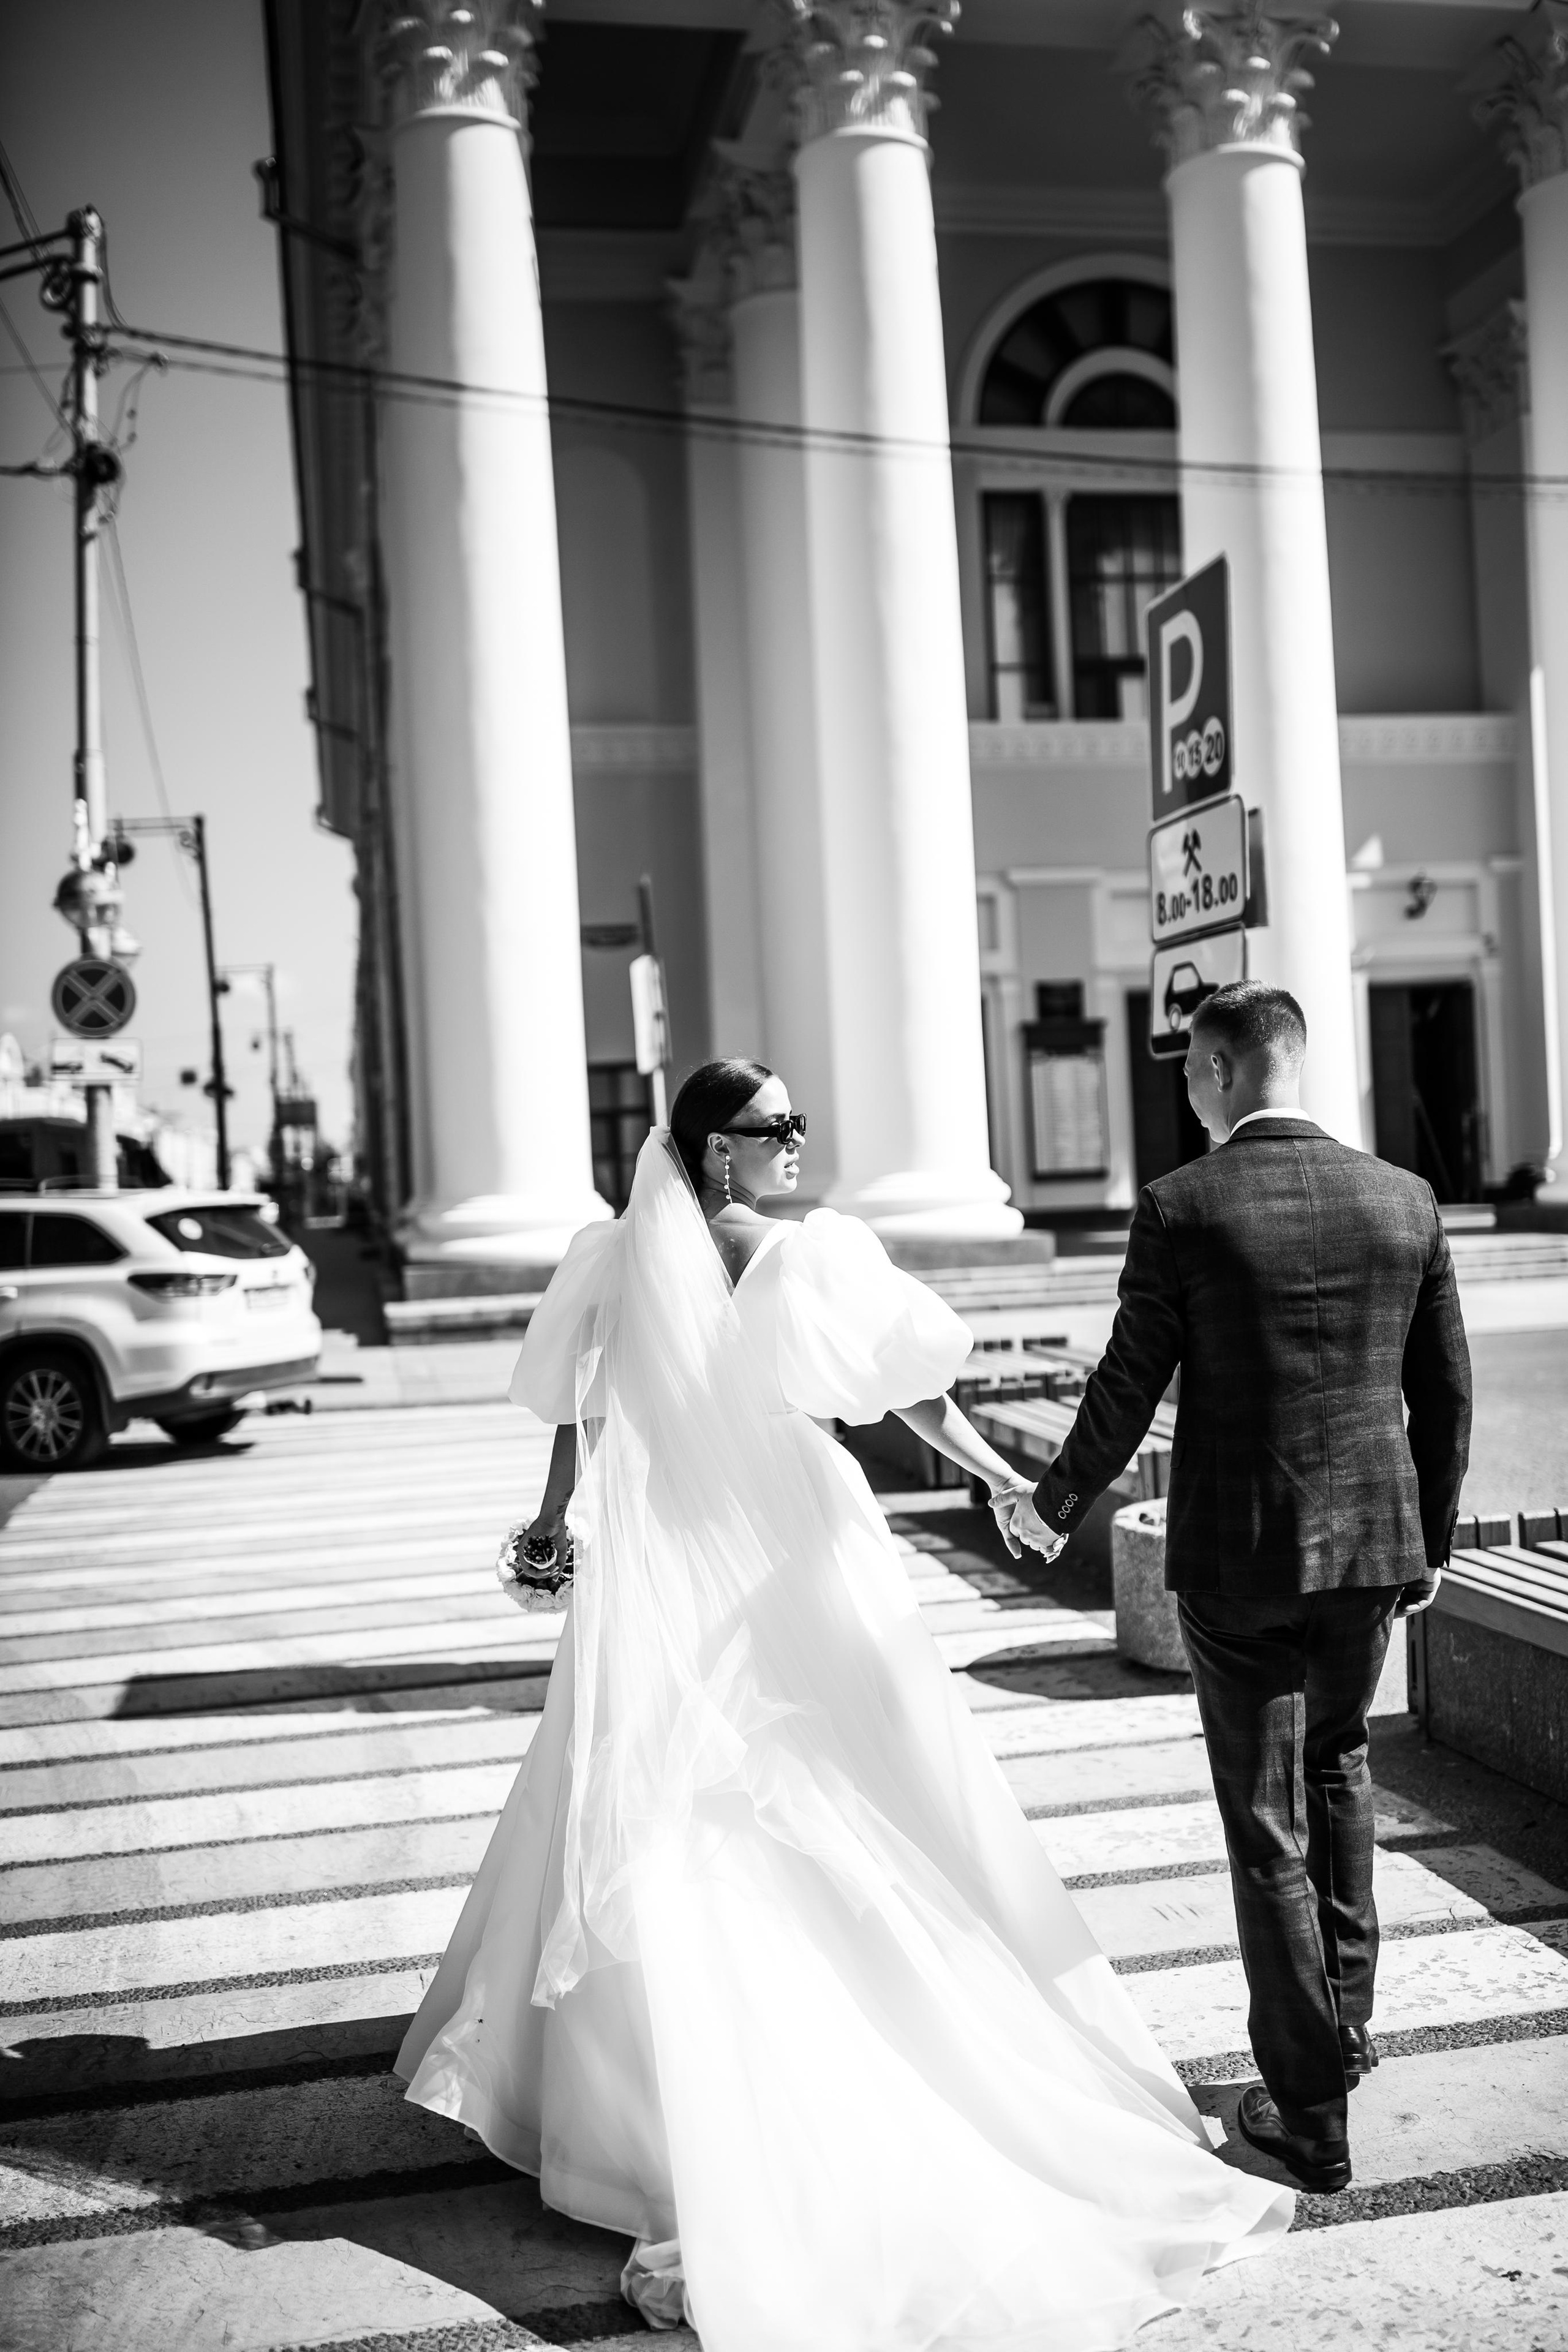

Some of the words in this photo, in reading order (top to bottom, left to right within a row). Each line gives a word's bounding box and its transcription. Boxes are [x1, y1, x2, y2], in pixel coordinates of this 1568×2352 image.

[1160, 609, 1204, 793] P
[1177, 751, 1186, 771] 10
[1189, 740, 1202, 767] 15
[1205, 731, 1224, 764] 20
[1156, 872, 1238, 927] 8.00-18.00
